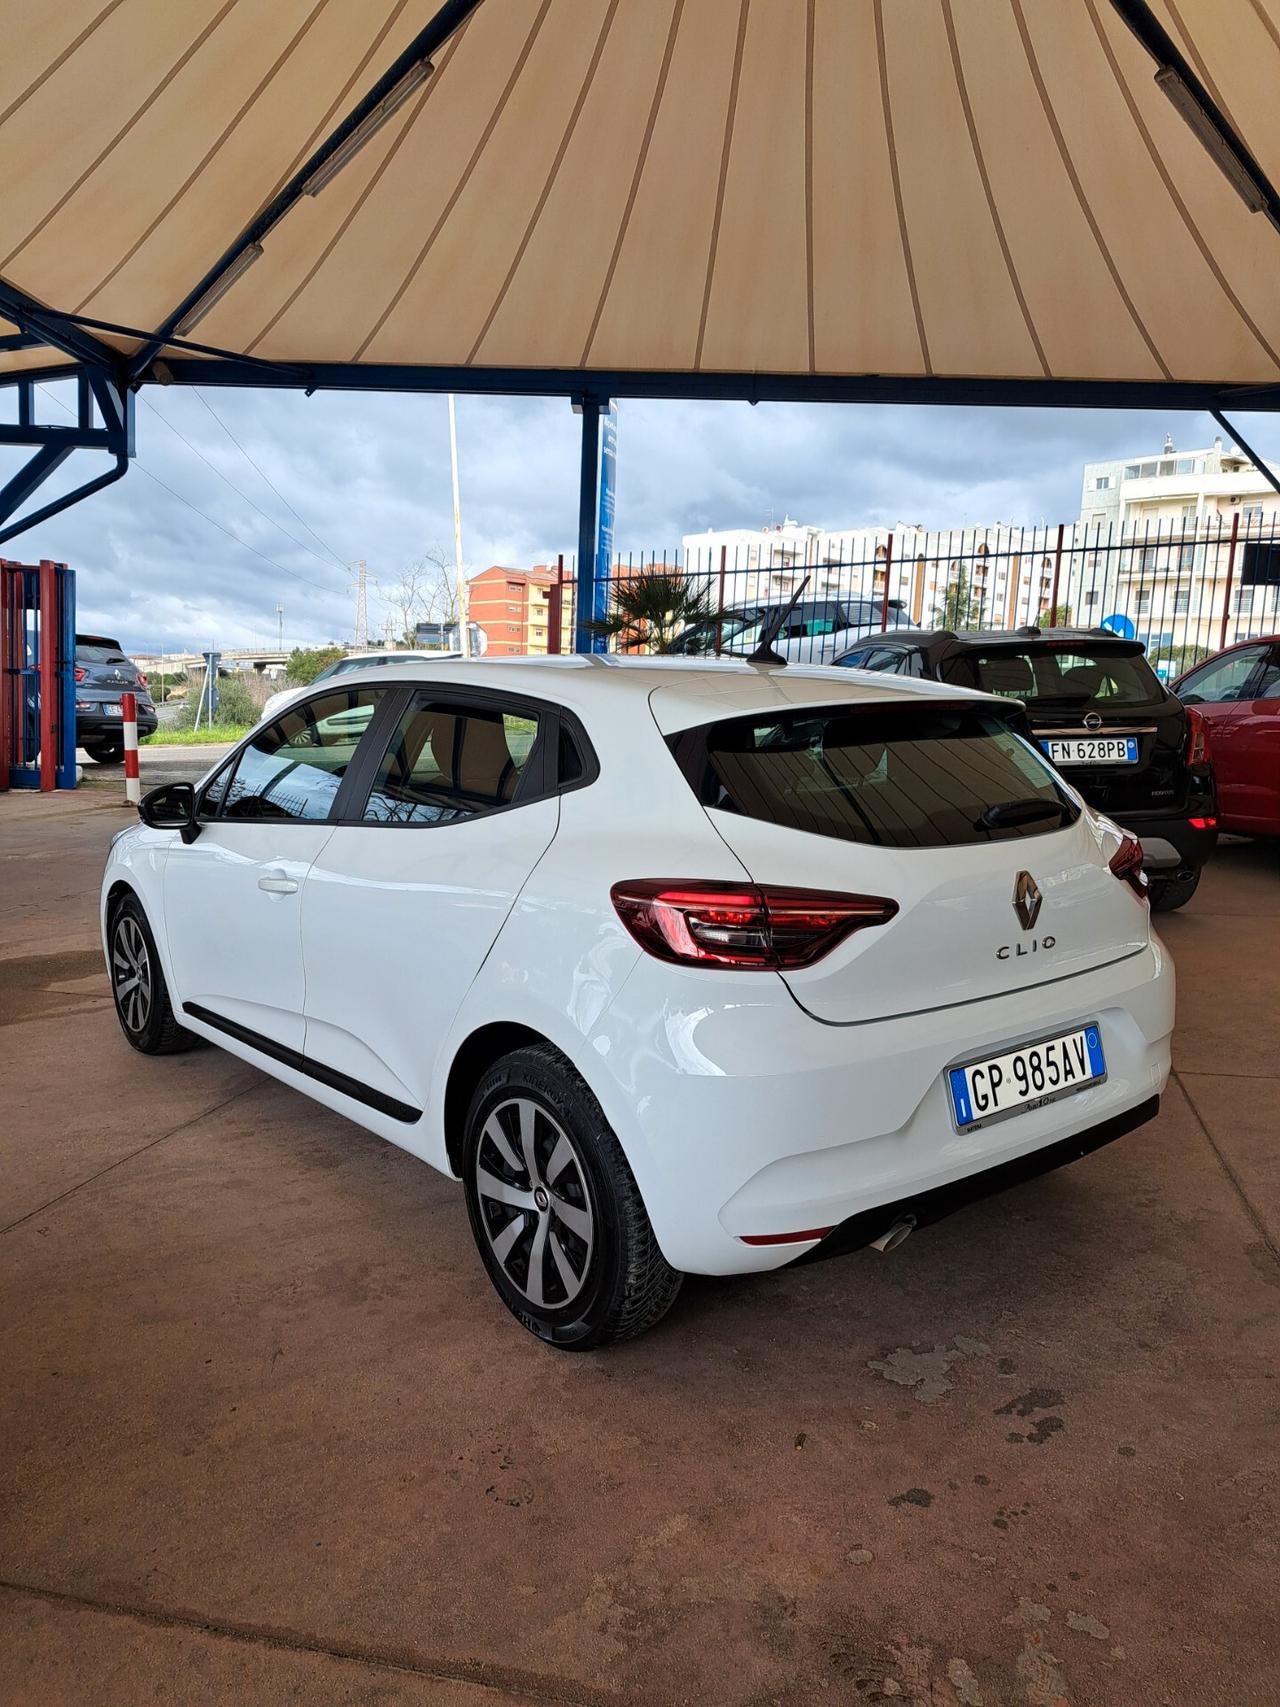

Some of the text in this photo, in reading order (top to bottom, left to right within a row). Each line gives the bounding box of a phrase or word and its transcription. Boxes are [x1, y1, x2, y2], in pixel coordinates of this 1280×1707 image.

[1051, 741, 1126, 759] FN 628PB
[996, 935, 1056, 960] CLIO
[971, 1036, 1087, 1112] GP 985AV
